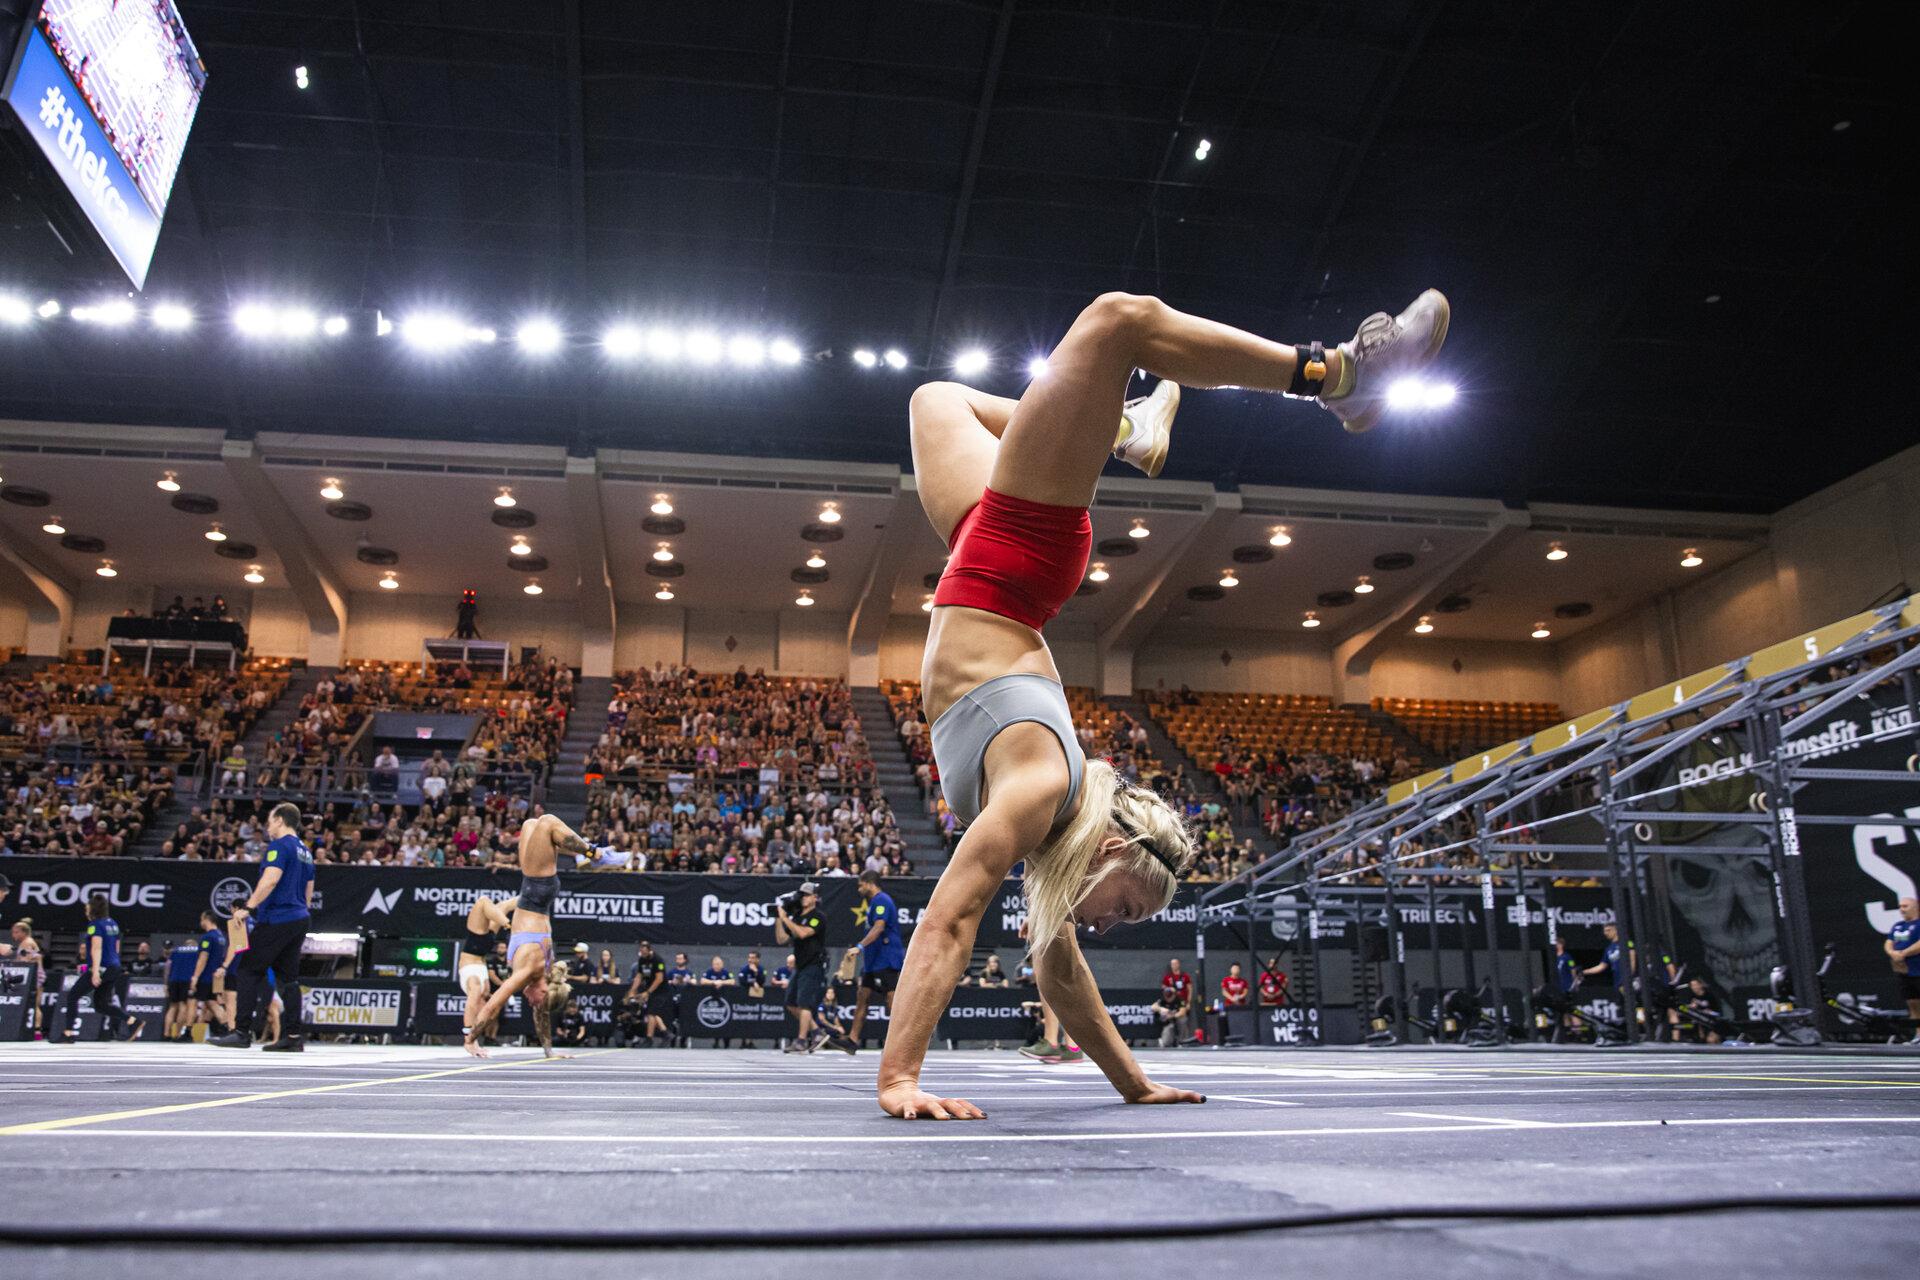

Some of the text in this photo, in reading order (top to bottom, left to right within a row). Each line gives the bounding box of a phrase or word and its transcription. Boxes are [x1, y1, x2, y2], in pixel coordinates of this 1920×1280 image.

[1804, 636, 1819, 662] 5
[19, 881, 165, 908] ROGUE
[435, 901, 475, 917] SPIR
[554, 897, 664, 917] KNOXVILLE
[701, 894, 777, 926] Cross
[312, 990, 399, 1008] SYNDICATE
[126, 1004, 163, 1013] ROGUE
[315, 1007, 373, 1024] CROWN
[949, 1007, 1022, 1018] GORUCK
